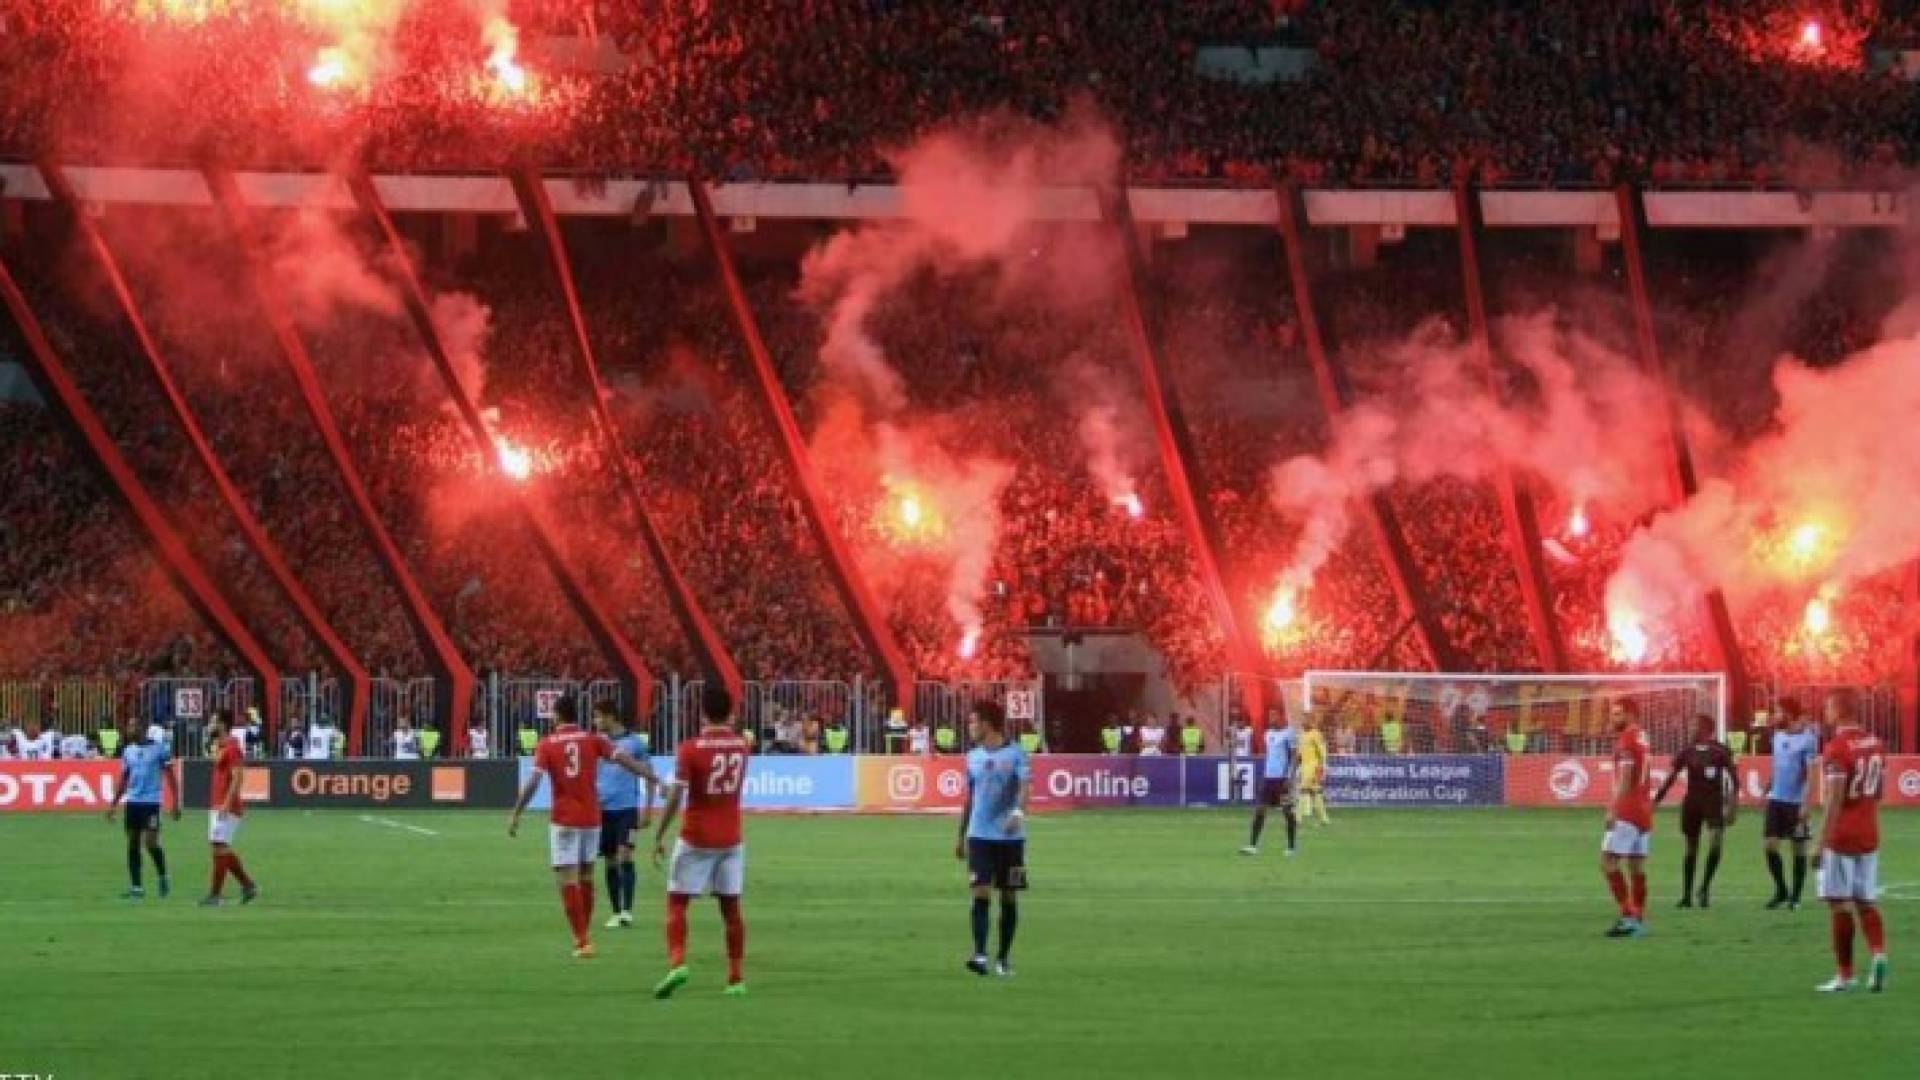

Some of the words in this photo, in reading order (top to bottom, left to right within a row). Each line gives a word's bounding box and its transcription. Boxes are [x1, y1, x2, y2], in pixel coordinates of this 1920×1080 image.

[564, 742, 579, 777] 3
[707, 752, 744, 795] 23
[1409, 763, 1470, 780] League
[291, 766, 411, 800] Orange
[744, 770, 813, 795] nline
[1433, 784, 1467, 803] Cup
